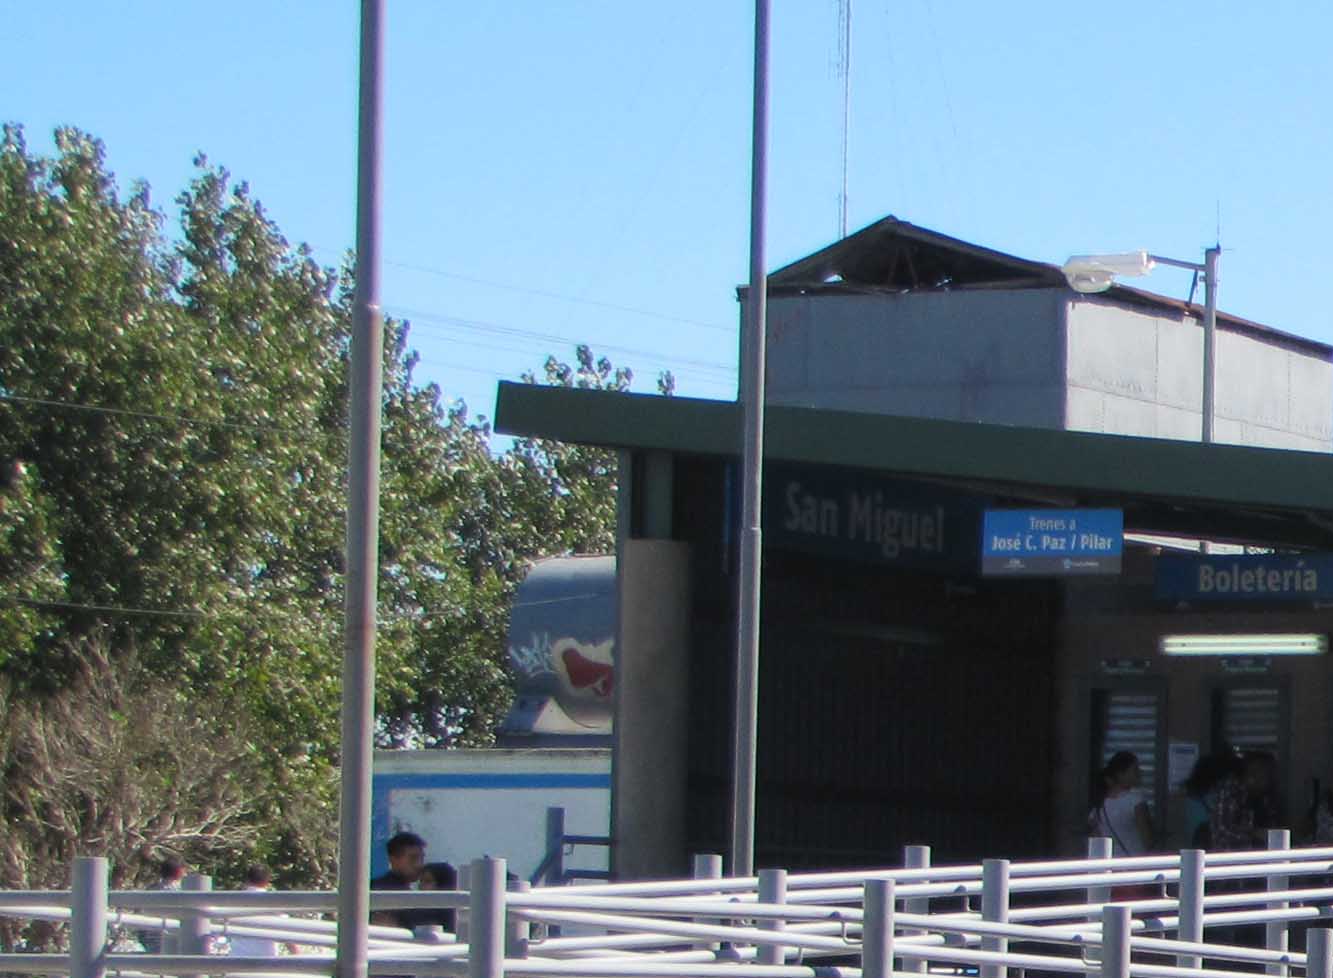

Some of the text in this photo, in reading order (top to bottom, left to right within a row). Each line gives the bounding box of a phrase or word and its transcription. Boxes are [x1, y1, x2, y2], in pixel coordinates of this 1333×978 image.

[785, 481, 945, 558] San Miguel
[1030, 517, 1077, 531] Trenes a
[992, 533, 1022, 551] José
[1025, 534, 1037, 551] C.
[1042, 535, 1066, 550] Paz
[1080, 533, 1113, 550] Pilar
[1199, 561, 1318, 592] Boletería
